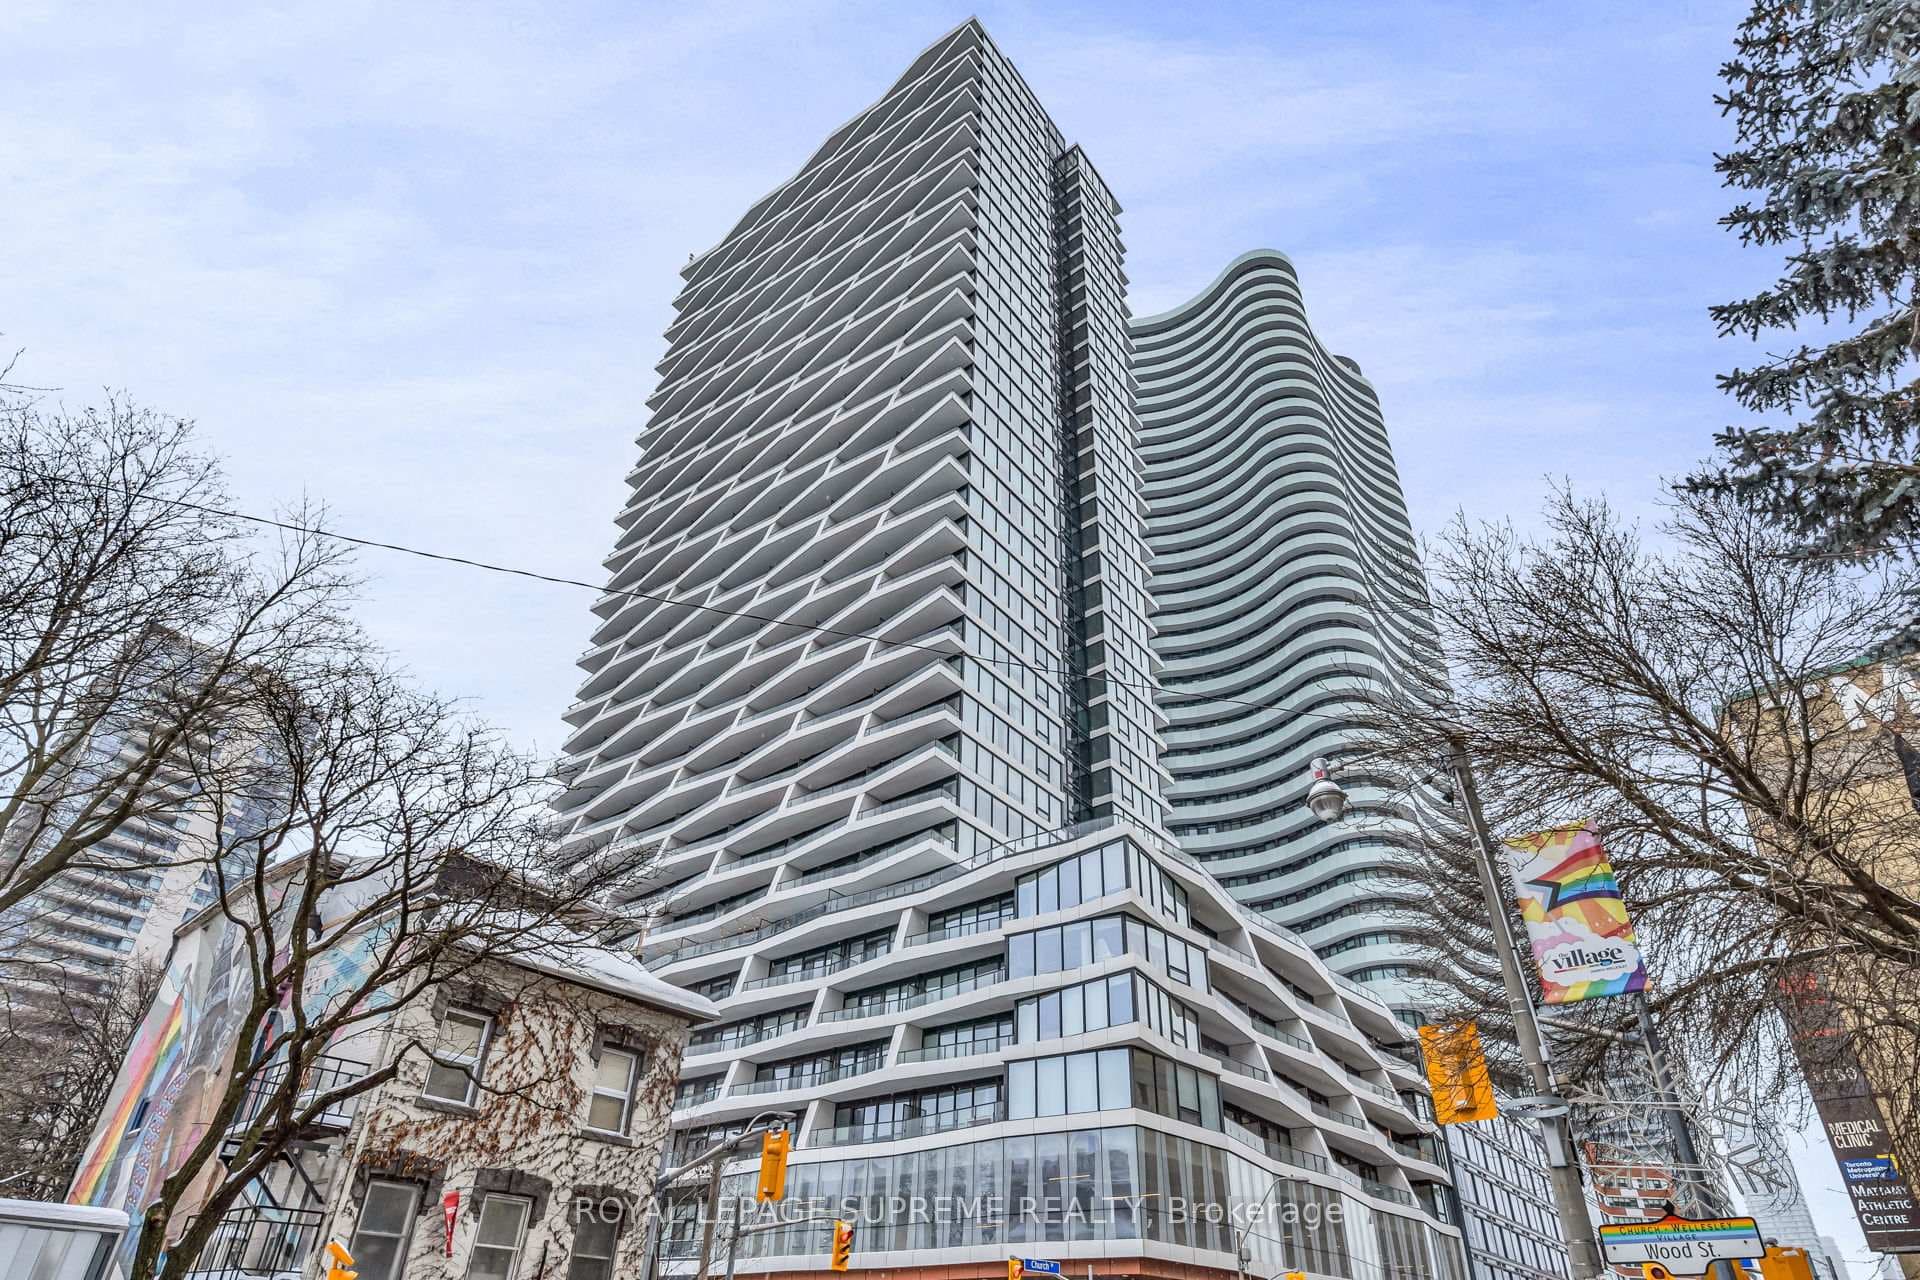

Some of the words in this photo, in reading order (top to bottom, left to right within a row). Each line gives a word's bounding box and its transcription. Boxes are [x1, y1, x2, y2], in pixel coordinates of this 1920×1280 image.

[1552, 947, 1623, 969] village
[1828, 1119, 1882, 1136] MEDICAL
[1833, 1134, 1873, 1149] CLINIC
[1862, 1212, 1911, 1226] CENTRE
[1619, 1226, 1660, 1236] CHURCH
[1670, 1222, 1733, 1233] WELLESLEY
[1656, 1233, 1697, 1242] VILLAGE
[1643, 1242, 1692, 1260] Wood
[1697, 1241, 1721, 1258] St.
